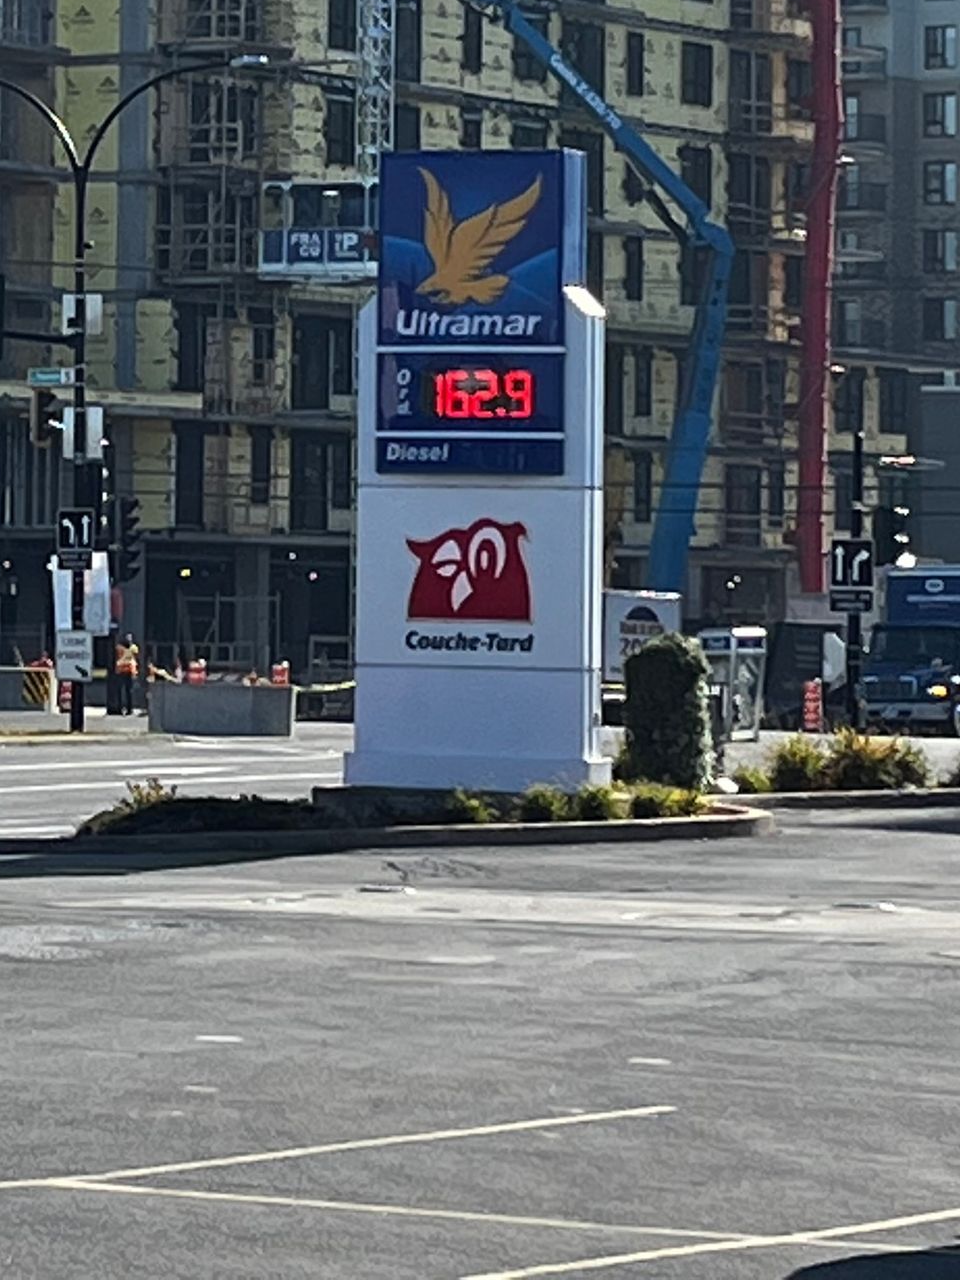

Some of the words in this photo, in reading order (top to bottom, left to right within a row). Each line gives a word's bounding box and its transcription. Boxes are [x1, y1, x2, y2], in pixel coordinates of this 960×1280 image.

[396, 308, 542, 337] Ultramar
[434, 369, 533, 418] 162.9
[386, 442, 451, 462] Diesel
[405, 629, 534, 652] Couche-Tard
